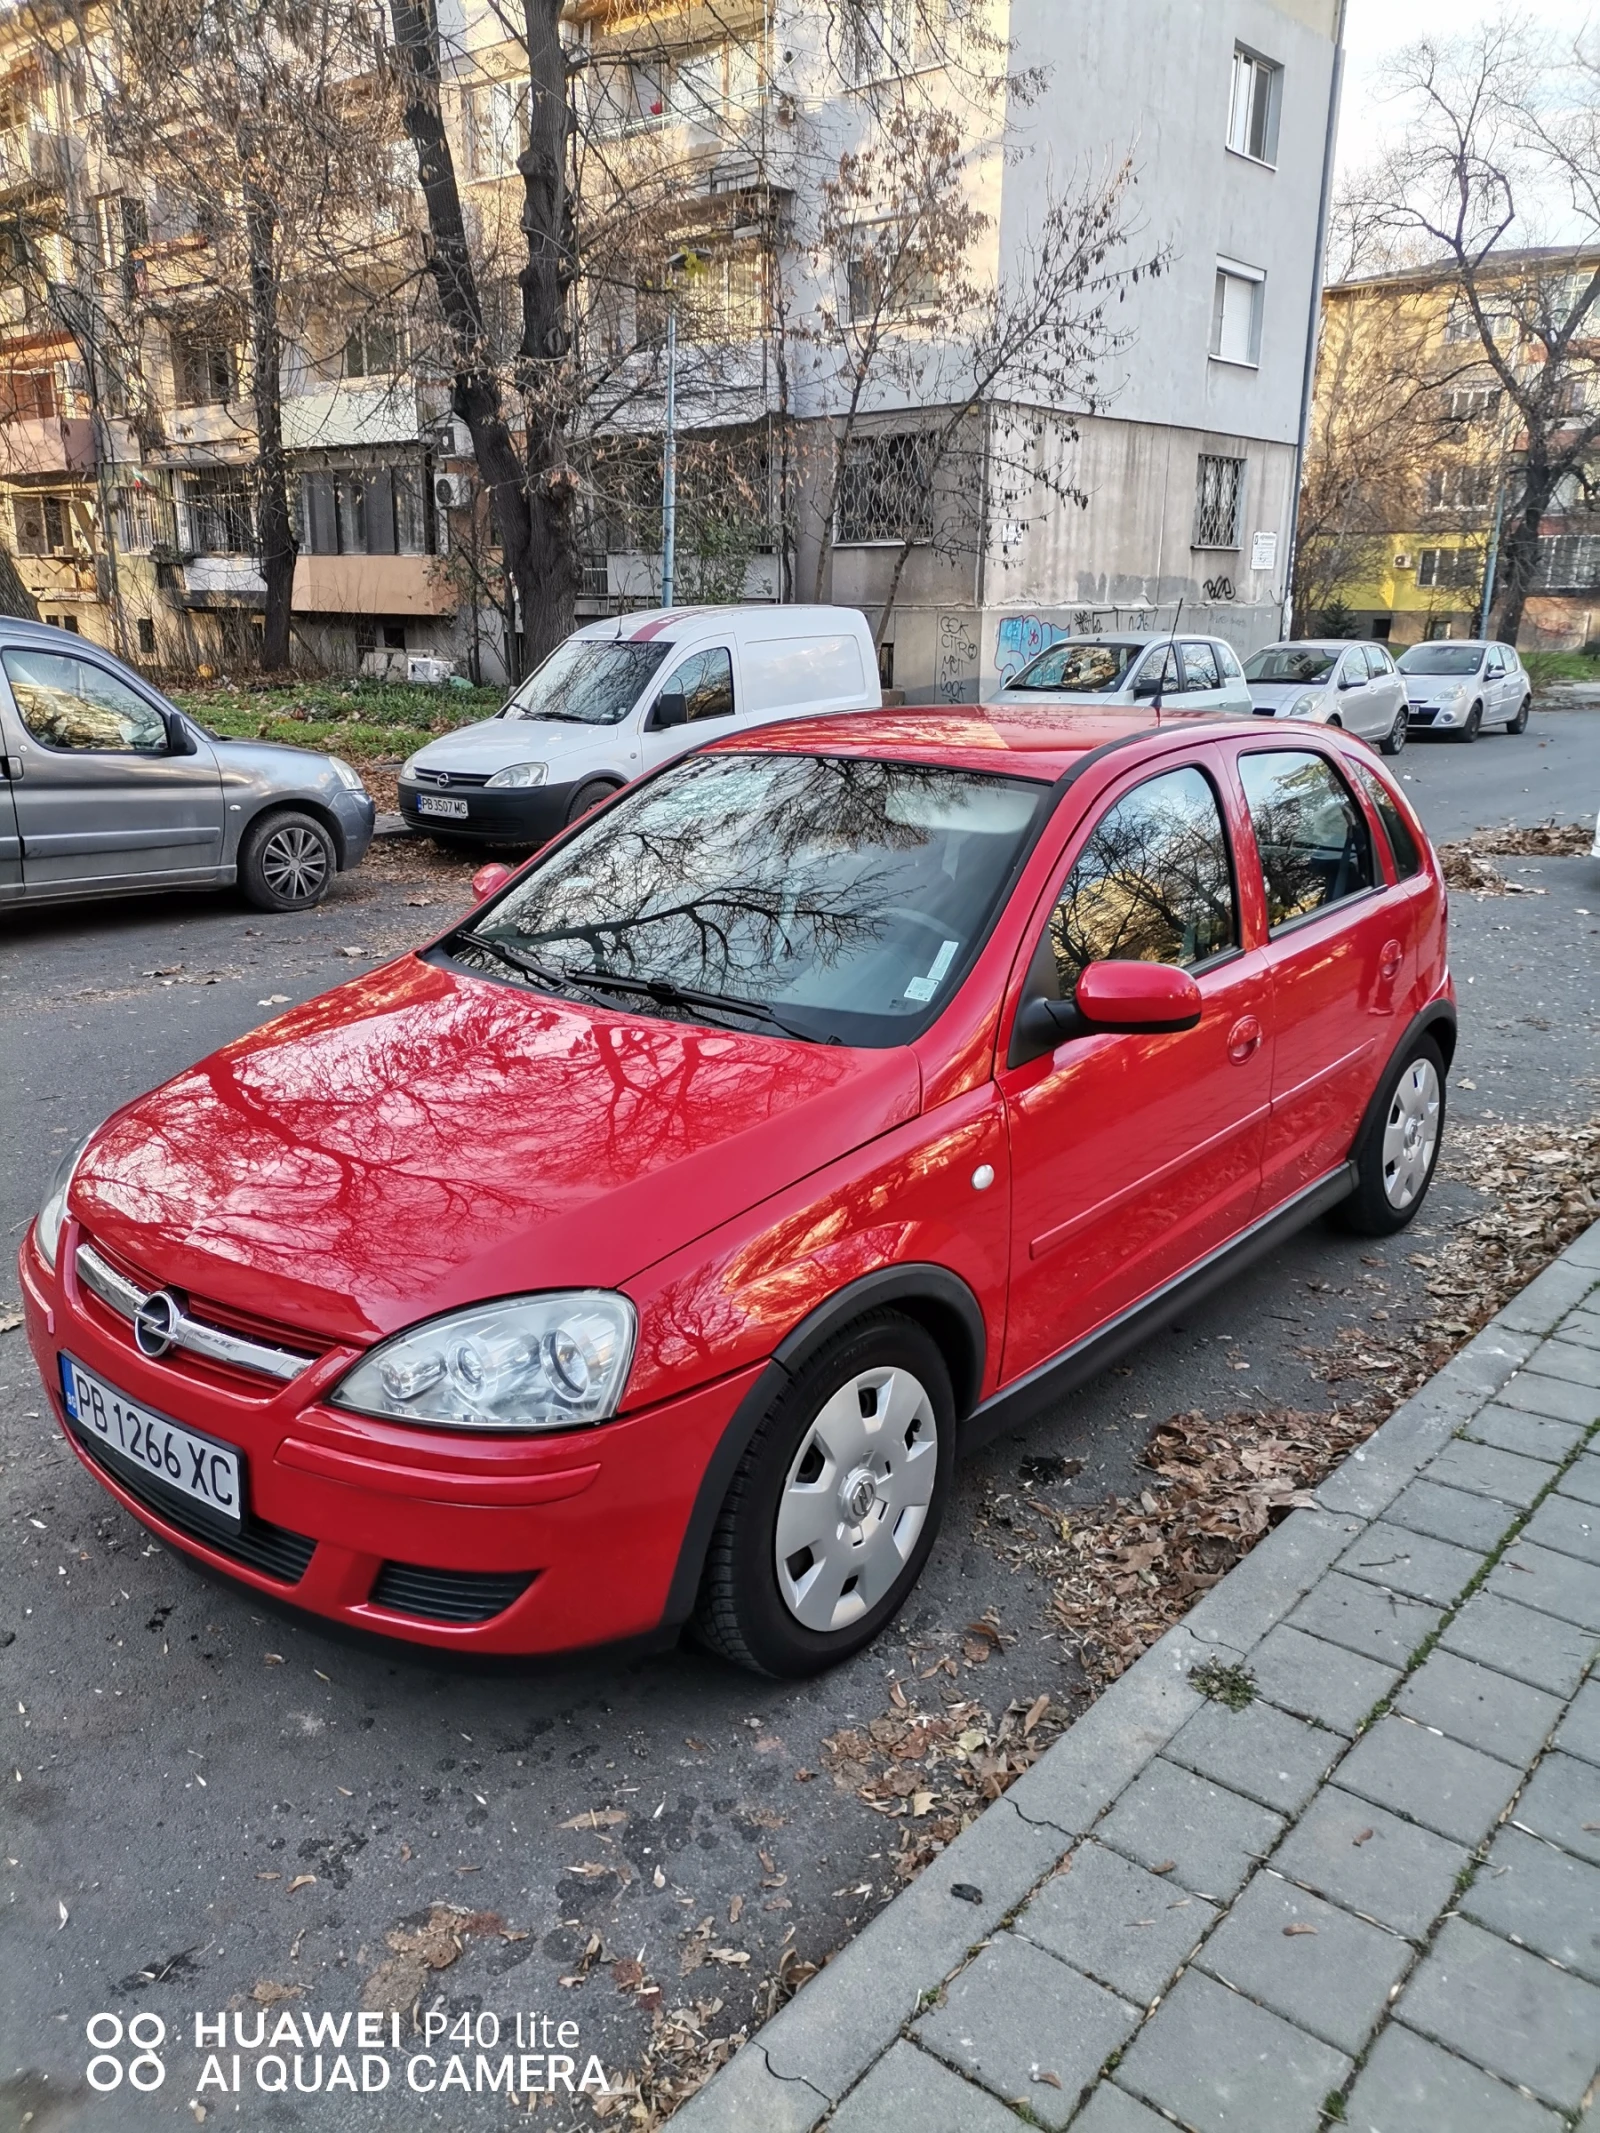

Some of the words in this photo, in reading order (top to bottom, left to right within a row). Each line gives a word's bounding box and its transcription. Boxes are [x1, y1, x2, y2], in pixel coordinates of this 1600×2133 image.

[422, 797, 434, 810] PB
[434, 799, 453, 813] 3507
[76, 1373, 108, 1433] PB
[113, 1402, 182, 1479] 1266
[187, 1441, 233, 1506] XC
